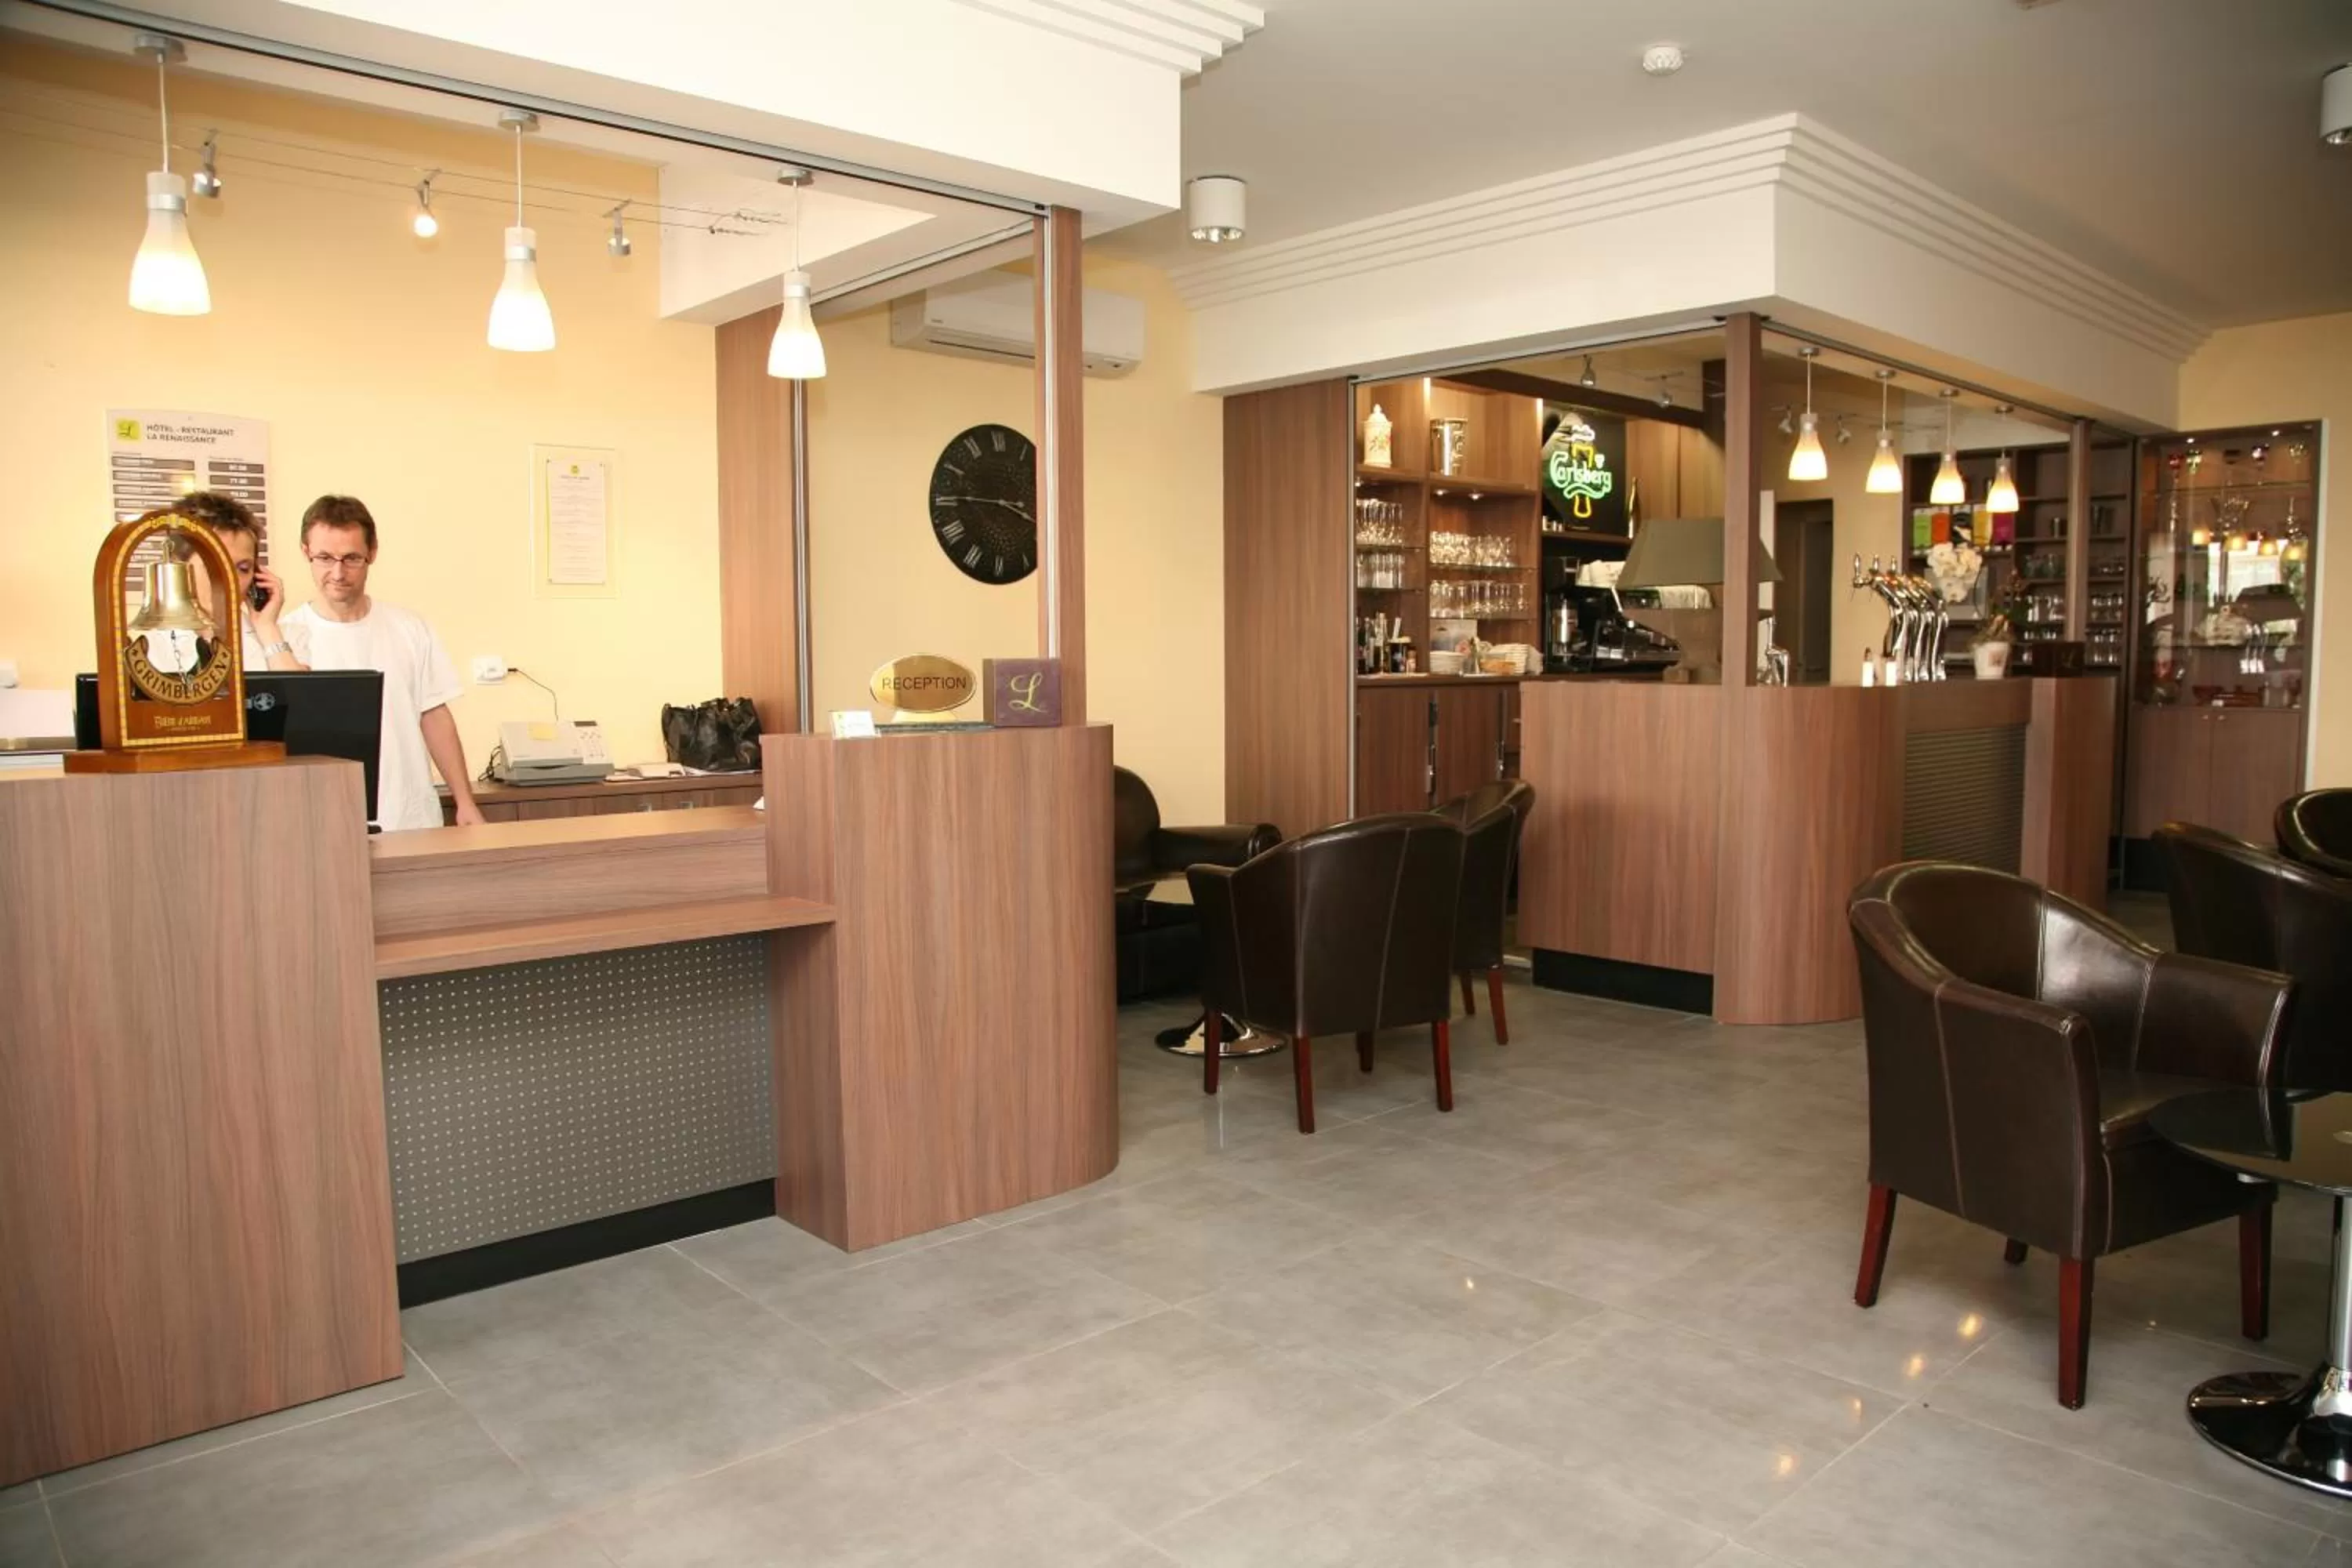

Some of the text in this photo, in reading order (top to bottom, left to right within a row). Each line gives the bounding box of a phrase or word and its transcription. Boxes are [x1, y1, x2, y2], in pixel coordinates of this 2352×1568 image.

[1550, 451, 1612, 493] Carlsberg
[134, 659, 227, 699] GRIMBERGEN
[882, 677, 967, 690] RECEPTION
